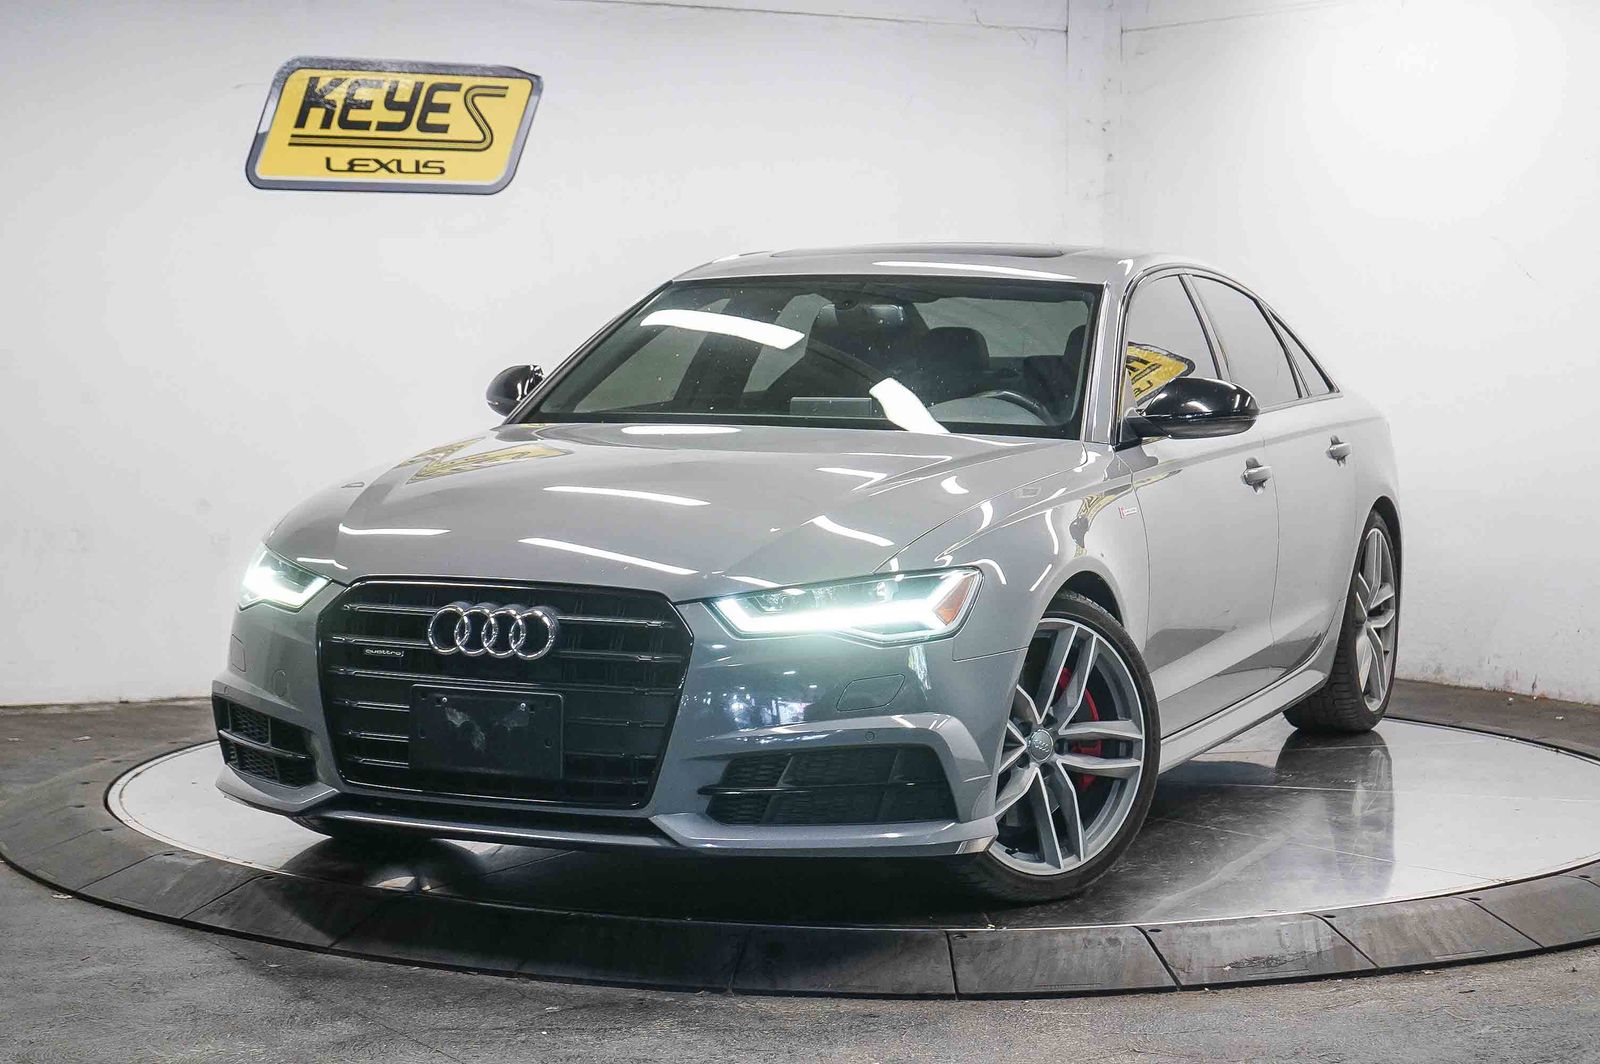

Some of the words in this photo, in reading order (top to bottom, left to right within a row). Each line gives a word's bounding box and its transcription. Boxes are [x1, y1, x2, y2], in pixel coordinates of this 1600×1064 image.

[292, 76, 509, 150] KEYES
[325, 156, 446, 175] LEXUS
[365, 649, 402, 657] quattro
